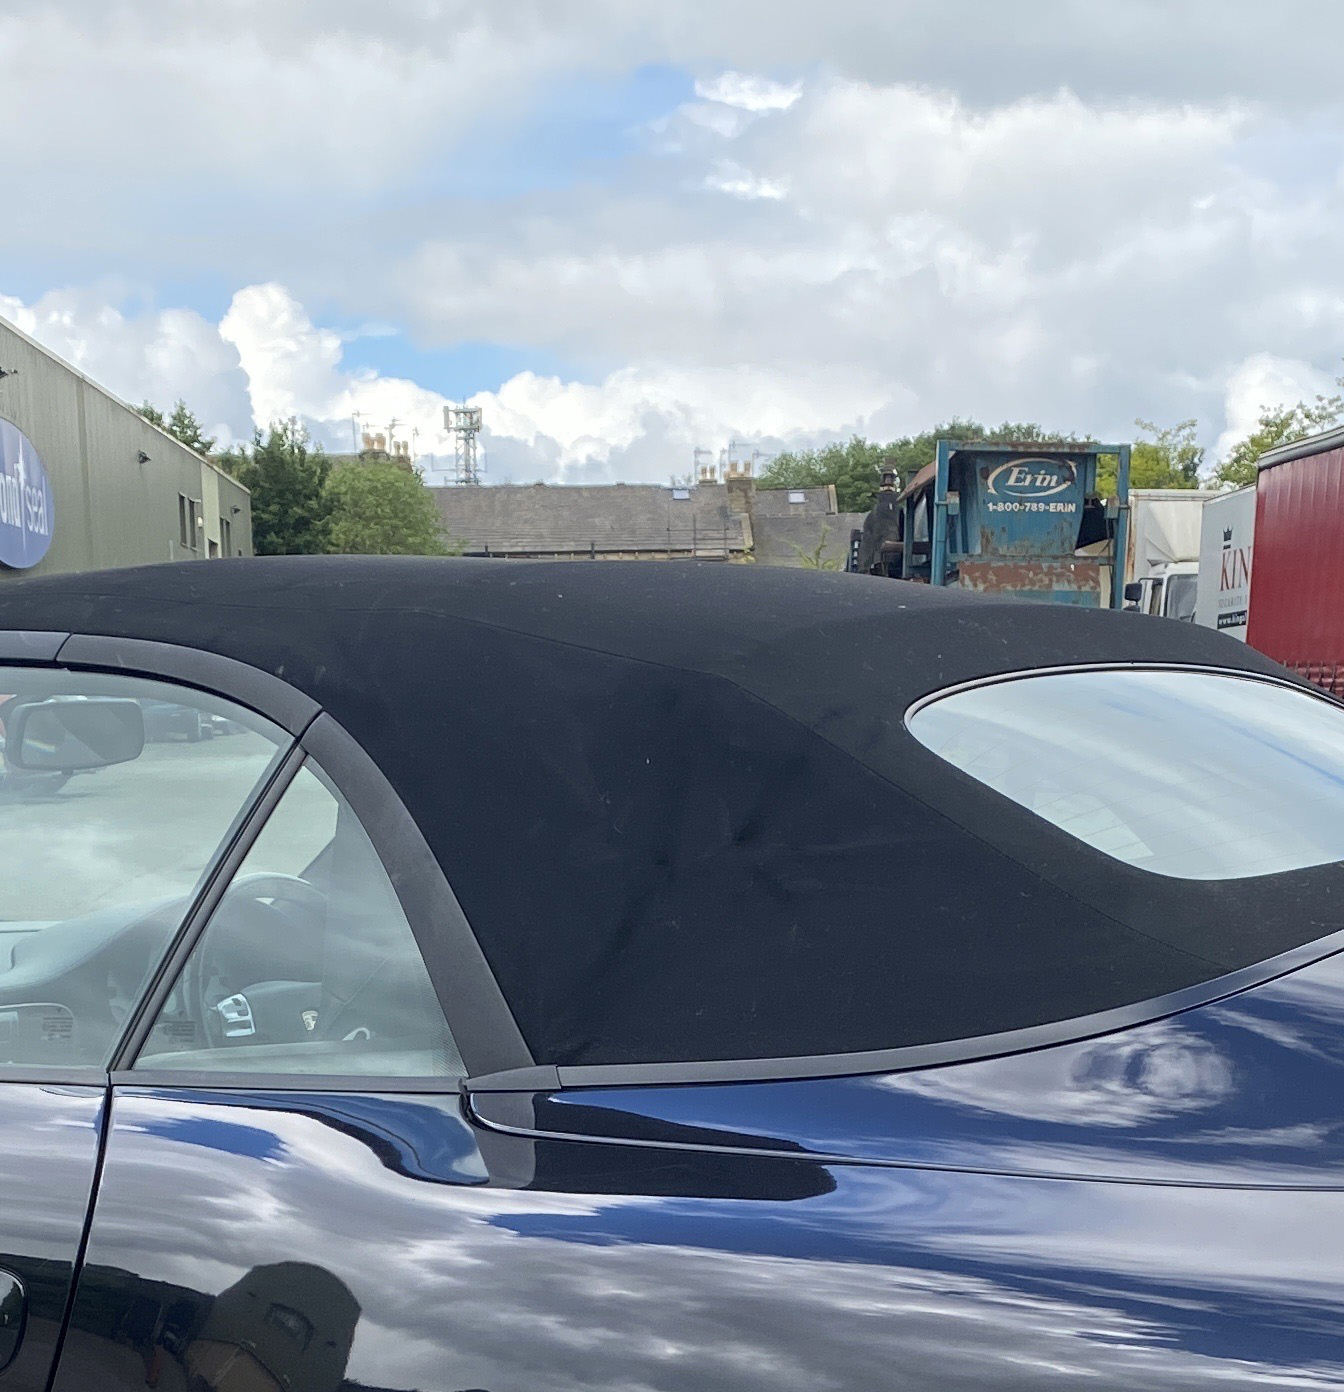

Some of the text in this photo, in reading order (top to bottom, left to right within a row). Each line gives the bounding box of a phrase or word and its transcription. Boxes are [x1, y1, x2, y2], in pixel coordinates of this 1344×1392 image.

[1005, 466, 1058, 487] Erin
[25, 474, 49, 536] seal
[987, 502, 1076, 513] 1-800-789-ERIN
